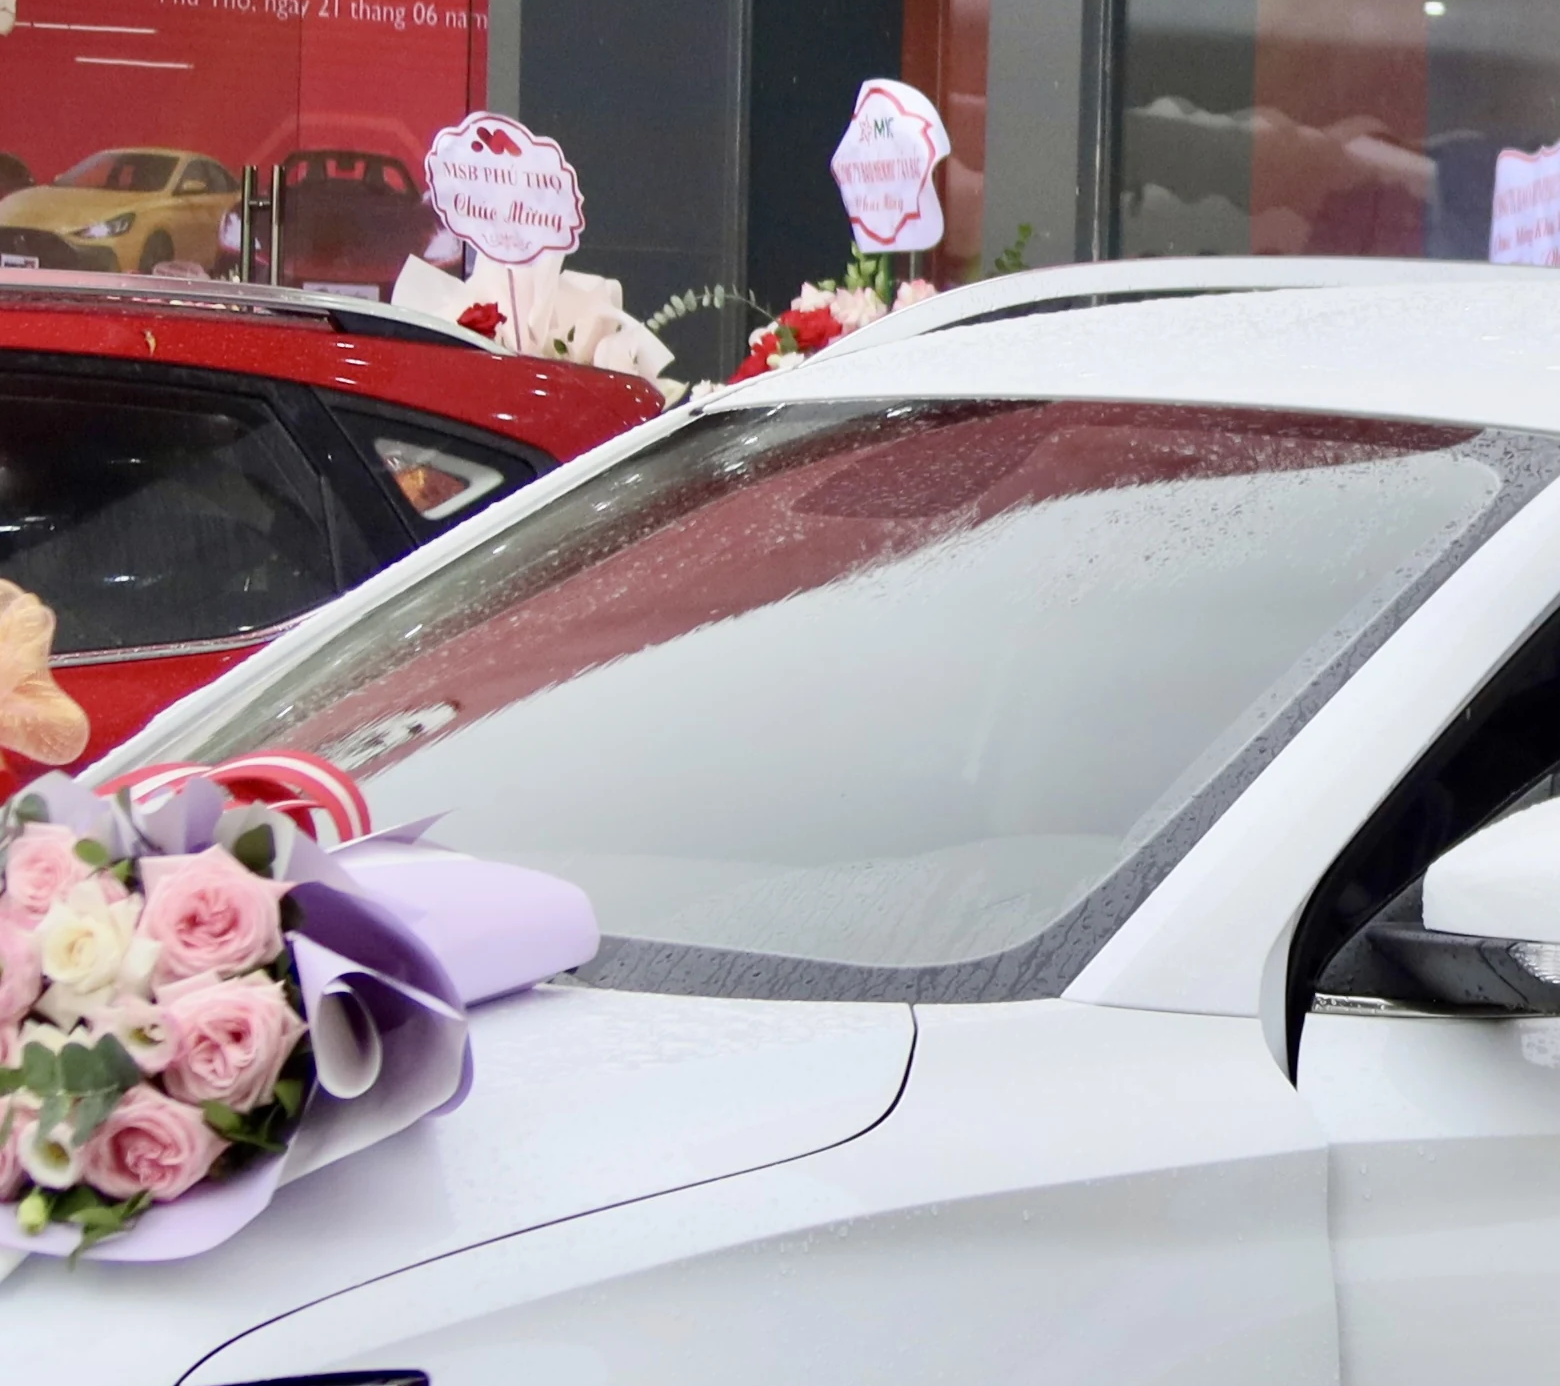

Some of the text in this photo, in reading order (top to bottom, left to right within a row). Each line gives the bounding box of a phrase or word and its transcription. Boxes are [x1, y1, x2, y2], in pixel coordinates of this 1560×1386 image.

[411, 0, 439, 27] 06
[442, 160, 562, 194] MSB PHÚ THỌ
[453, 192, 563, 234] Chúc Mừng
